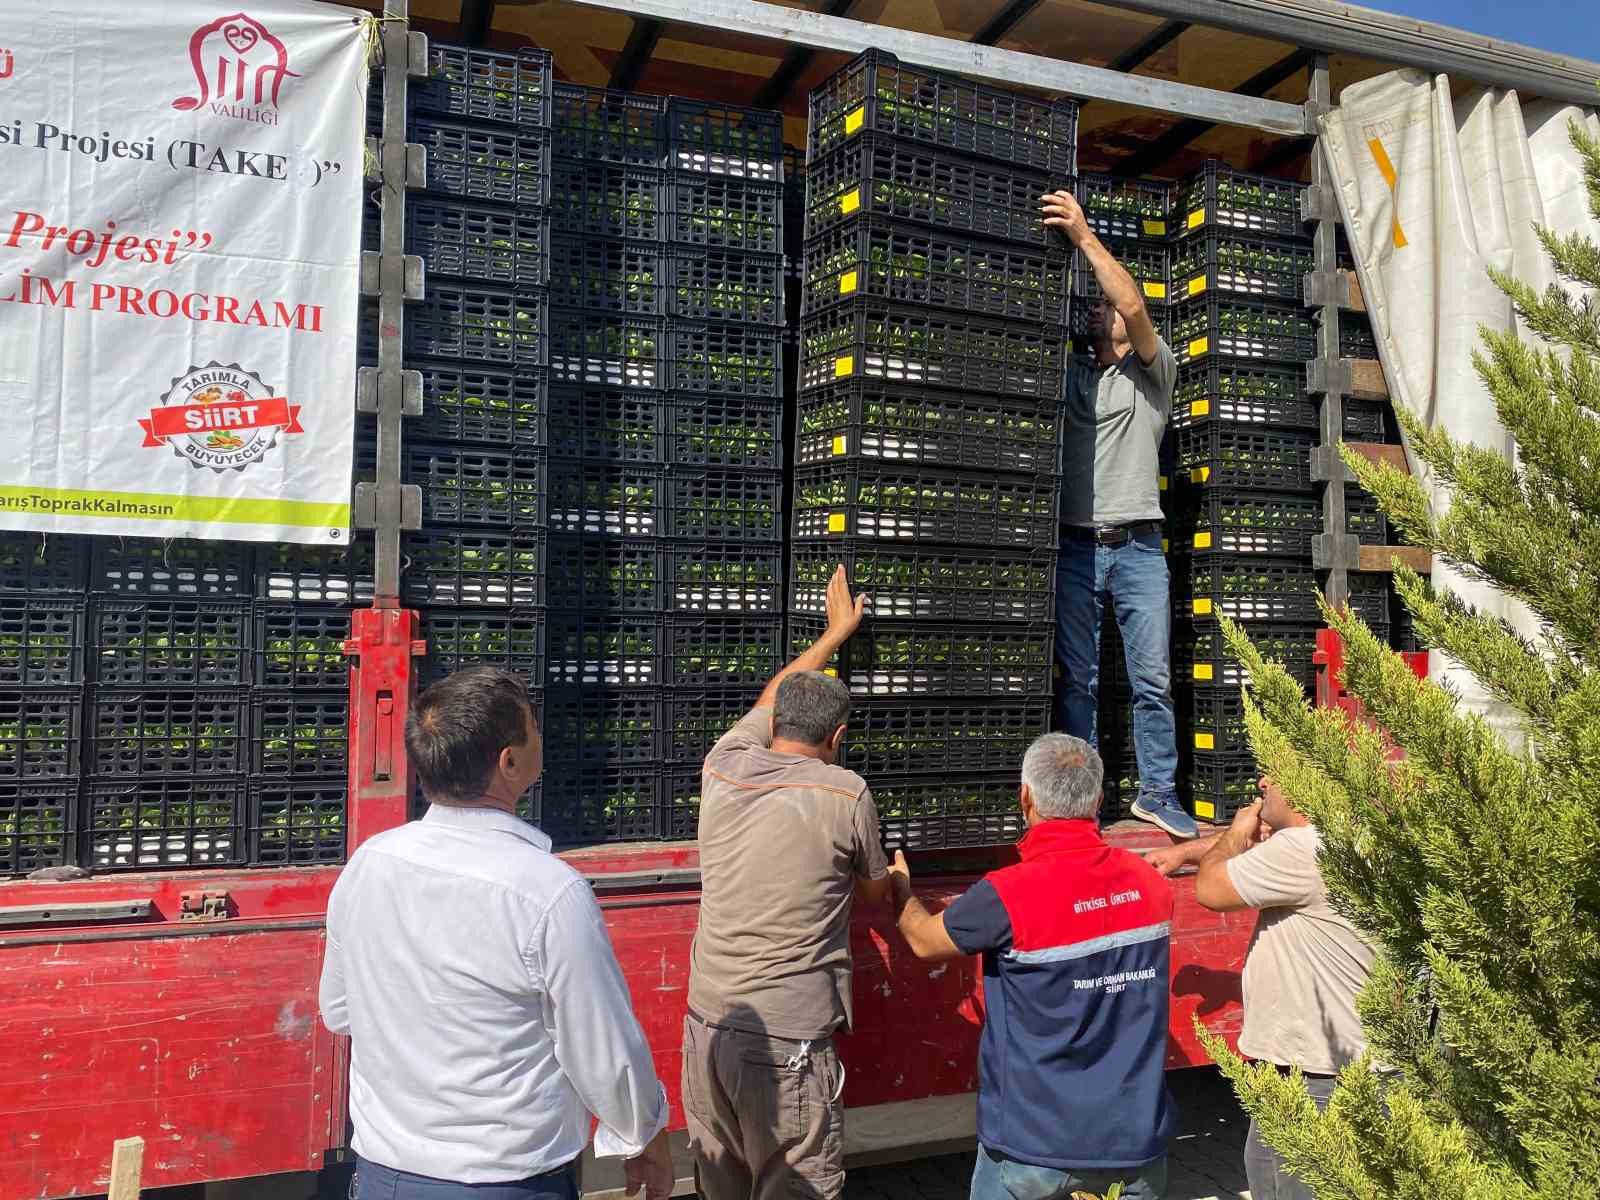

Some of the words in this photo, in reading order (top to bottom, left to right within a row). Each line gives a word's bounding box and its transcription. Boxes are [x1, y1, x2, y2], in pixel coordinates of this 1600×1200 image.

[33, 121, 155, 163] Projesi
[88, 282, 324, 333] PROGRAMI
[182, 371, 251, 393] TARIMLA
[1073, 896, 1109, 914] BİTKİSEL
[1110, 888, 1142, 906] ÜRETİM
[1073, 977, 1095, 990] TARIM
[1095, 976, 1104, 988] VE
[1103, 972, 1125, 985] ORMAN
